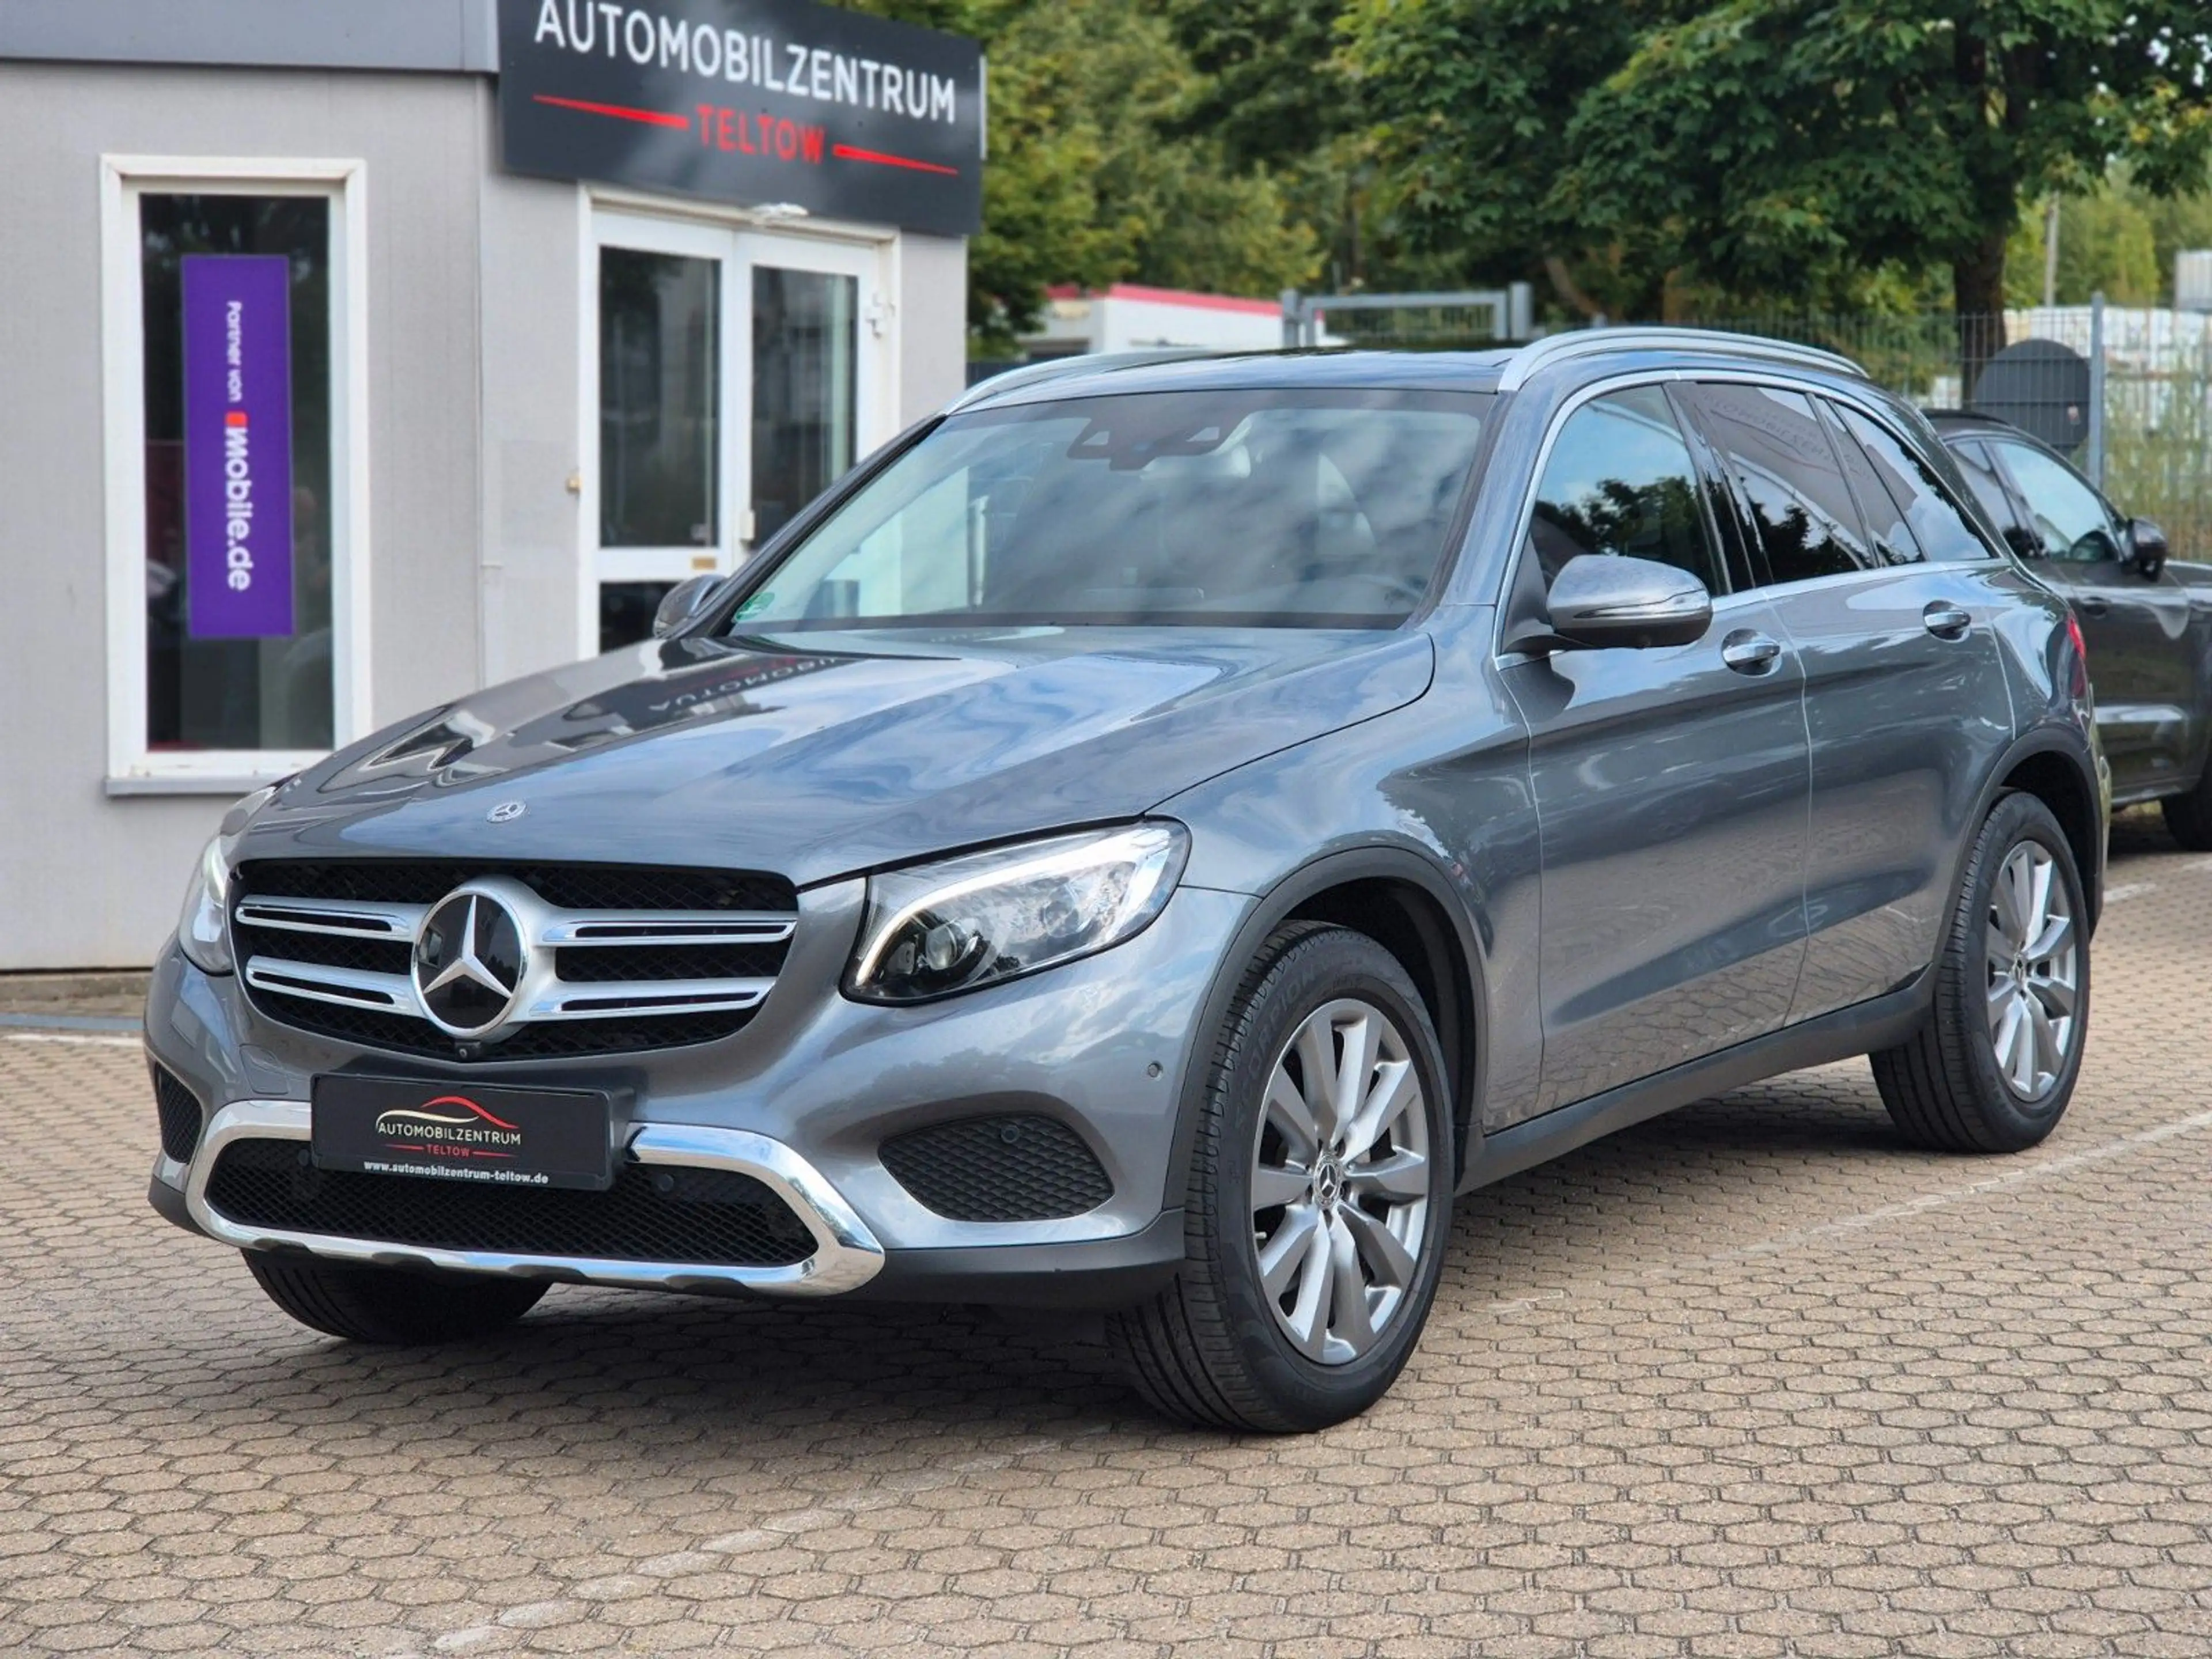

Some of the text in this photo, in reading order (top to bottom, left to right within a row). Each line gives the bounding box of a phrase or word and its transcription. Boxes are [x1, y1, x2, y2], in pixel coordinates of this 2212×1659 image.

[534, 0, 956, 123] AUTOMOBILZENTRUM
[696, 104, 826, 164] TELTOW
[225, 300, 253, 591] Partner von mobile.de
[378, 1123, 521, 1145] AUTOMOBILZENTRUM
[426, 1143, 469, 1157] TELTOW
[363, 1161, 549, 1184] www.automobilzentrum-teltow.de
